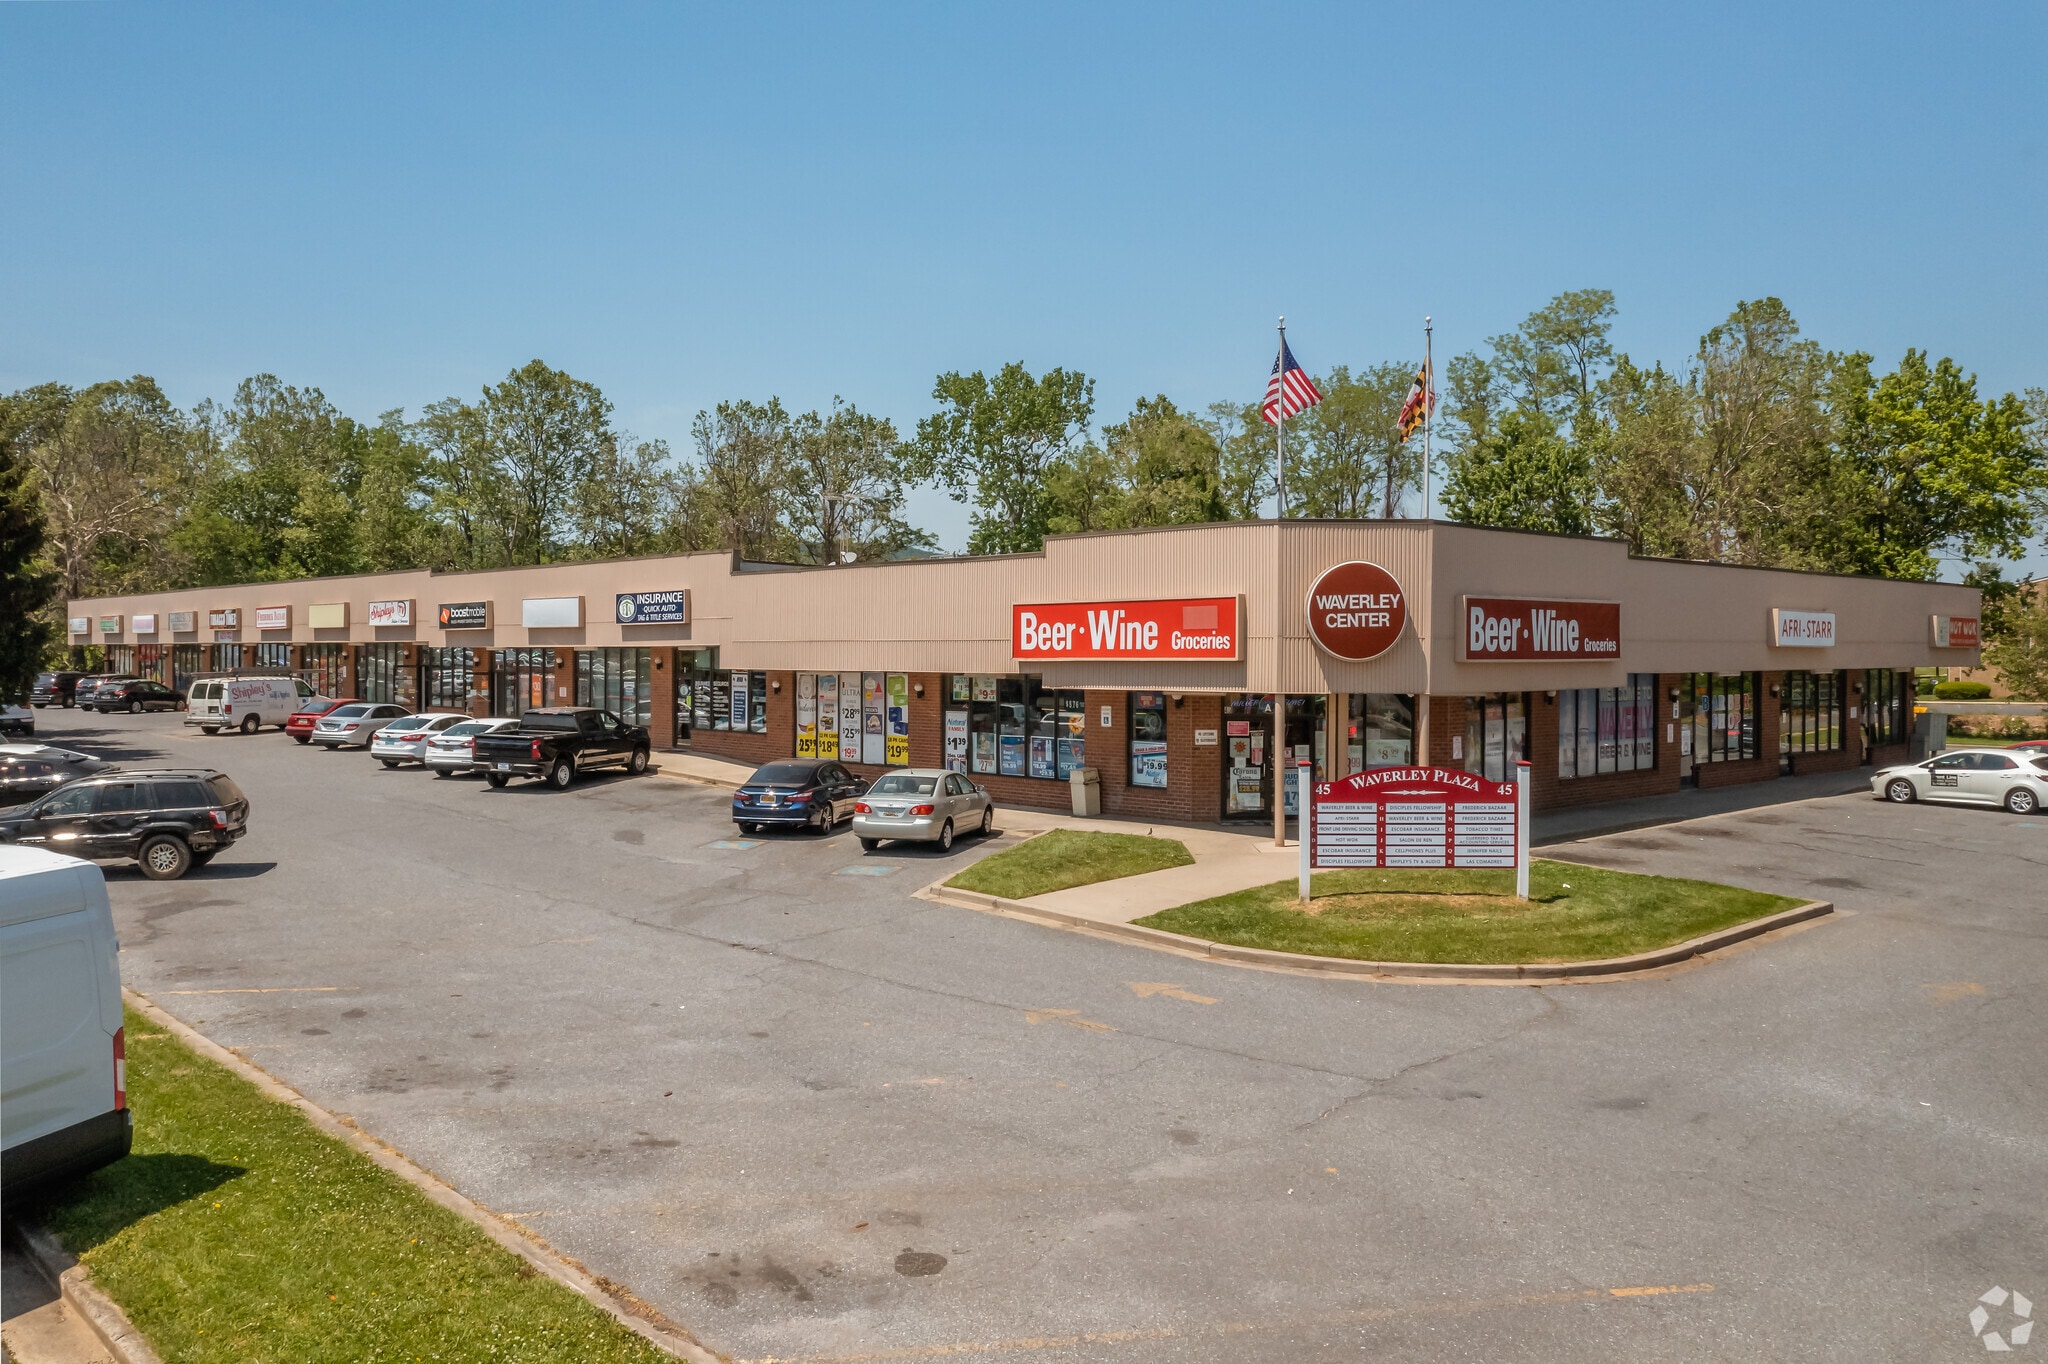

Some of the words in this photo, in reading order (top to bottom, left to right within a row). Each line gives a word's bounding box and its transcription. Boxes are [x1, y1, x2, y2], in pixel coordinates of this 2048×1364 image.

[637, 592, 683, 604] INSURANCE
[1316, 594, 1400, 610] WAVERLEY
[1326, 612, 1390, 628] CENTER
[1020, 612, 1073, 651] Beer
[1088, 610, 1158, 650] Wine
[1172, 631, 1230, 650] Groceries
[1470, 607, 1521, 652] Beer
[1531, 609, 1579, 652] Wine
[1584, 638, 1616, 652] Groceries
[232, 682, 272, 699] Shipley's
[1643, 687, 1652, 700] TO
[1600, 745, 1622, 759] BEER
[1624, 744, 1629, 757] &
[1631, 742, 1651, 756] WINE
[1315, 784, 1331, 794] 45
[1349, 770, 1430, 789] WAVERLEY
[1433, 770, 1479, 792] PLAZA
[1497, 784, 1512, 795] 45
